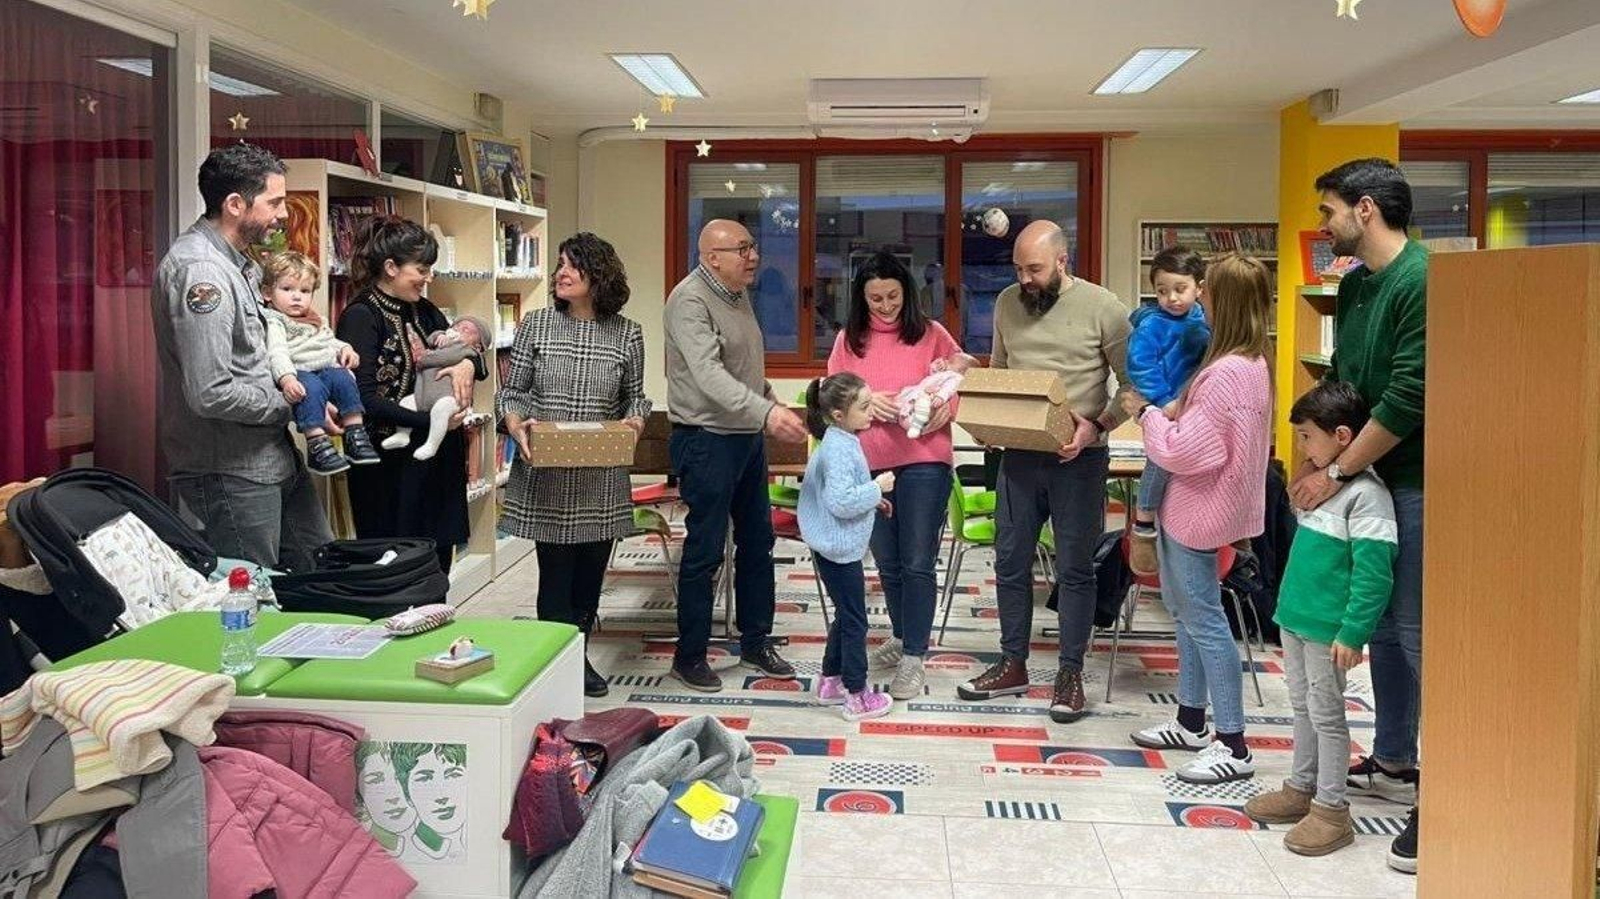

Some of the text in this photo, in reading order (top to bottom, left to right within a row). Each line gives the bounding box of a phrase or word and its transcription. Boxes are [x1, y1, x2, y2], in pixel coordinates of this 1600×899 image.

[699, 697, 753, 705] cours
[912, 704, 1037, 714] racing cours
[896, 724, 995, 736] SPEED UP
